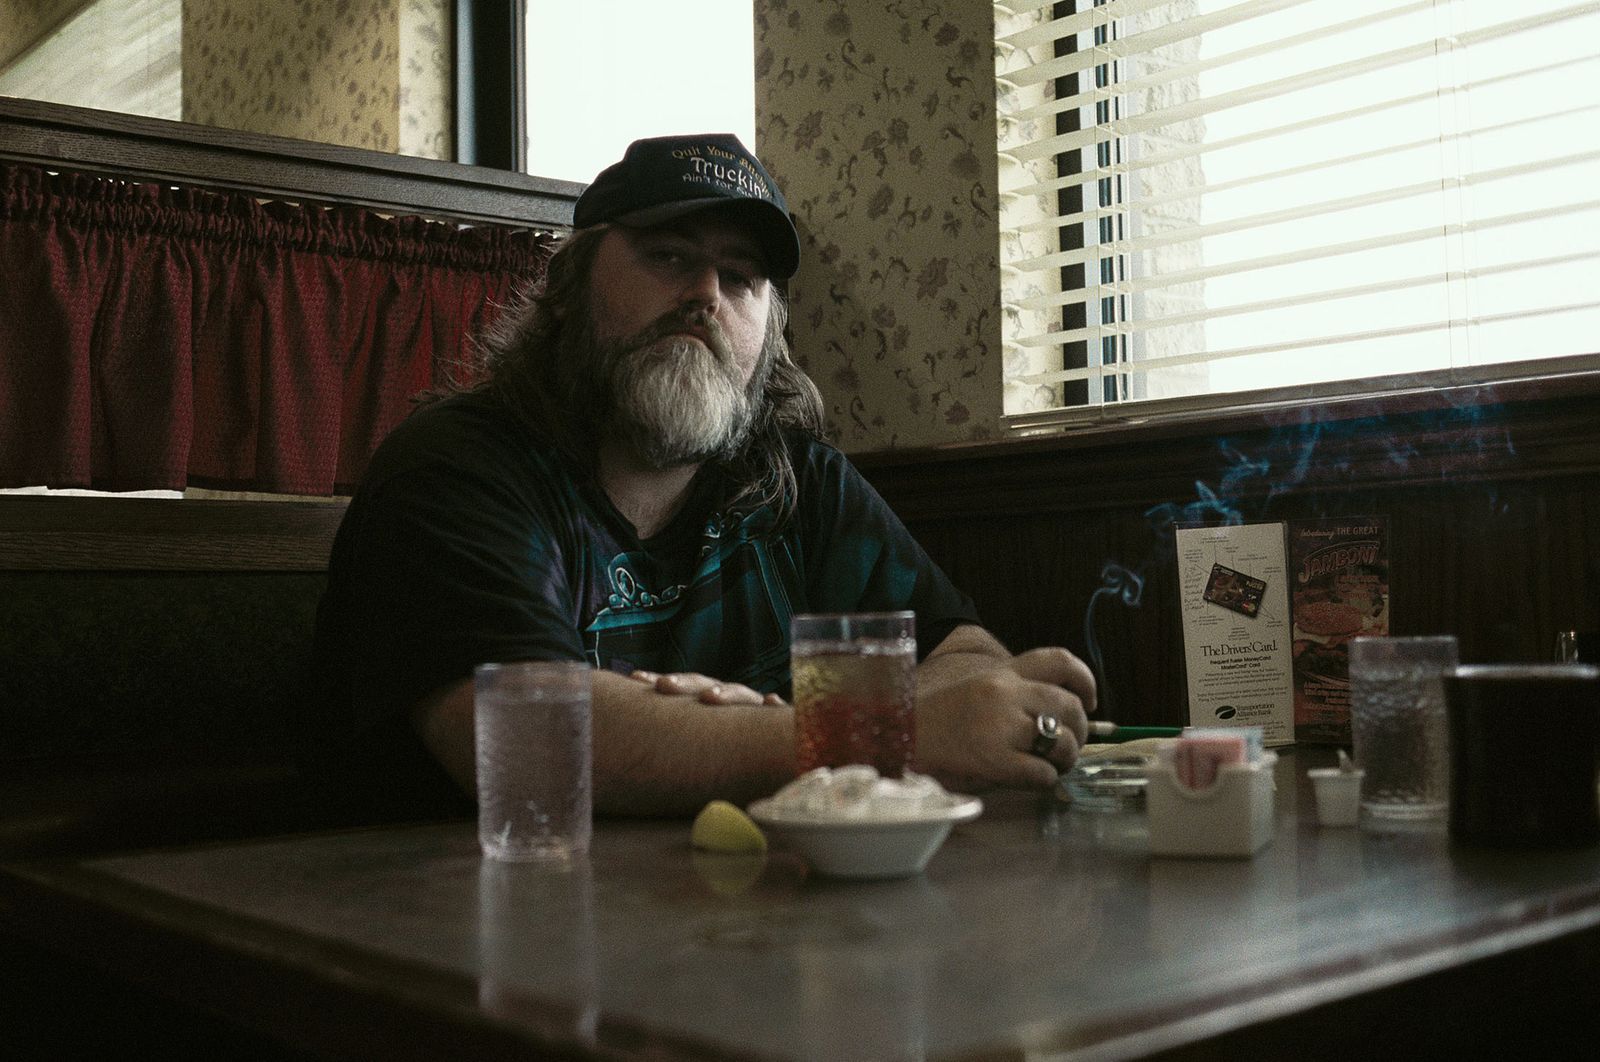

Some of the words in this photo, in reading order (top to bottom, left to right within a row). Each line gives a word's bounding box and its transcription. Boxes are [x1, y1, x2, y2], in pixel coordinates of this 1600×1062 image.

[672, 146, 700, 159] Quit
[706, 145, 735, 160] Your
[682, 173, 711, 184] Ain't
[1337, 527, 1349, 535] THE
[1353, 526, 1378, 536] GREAT
[1200, 645, 1220, 657] The
